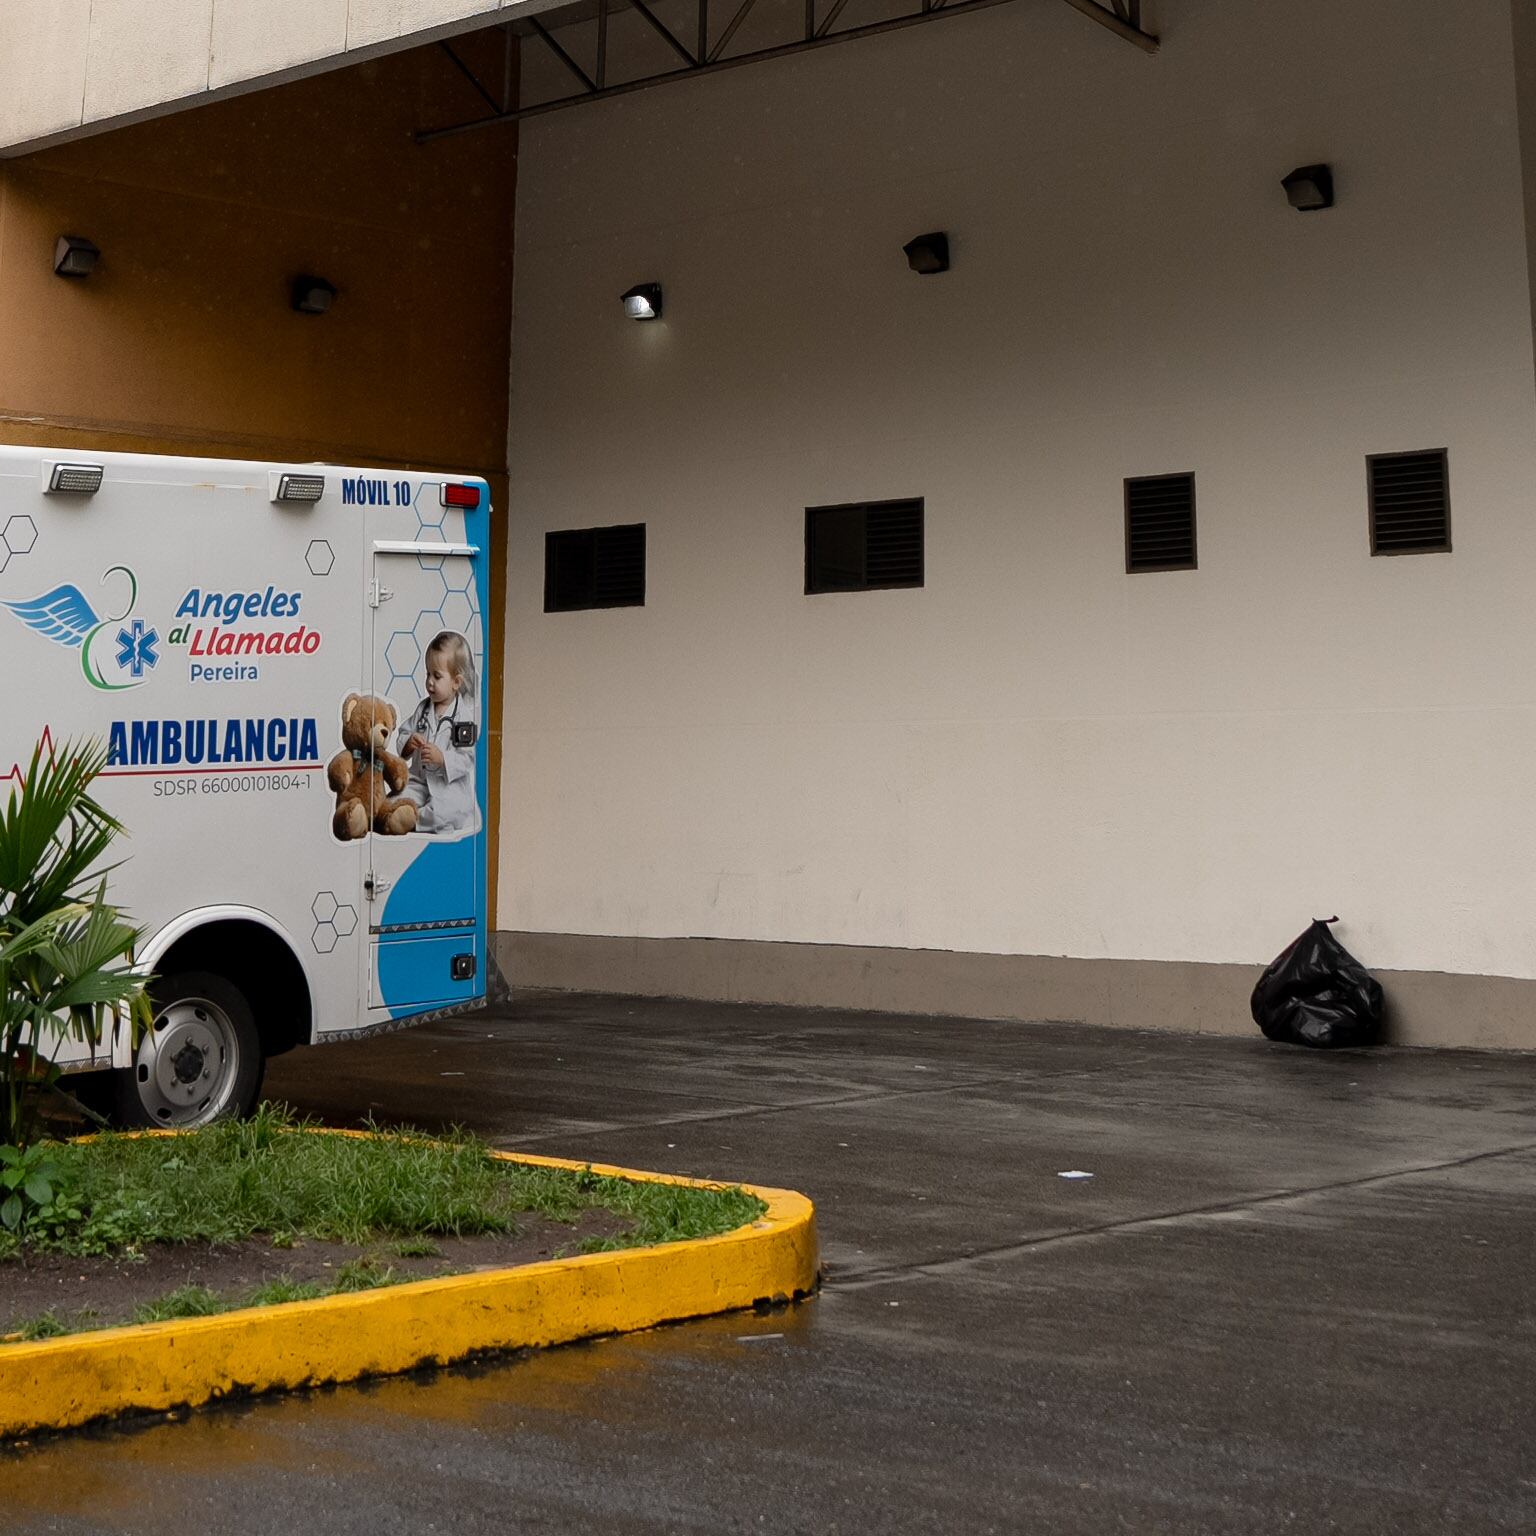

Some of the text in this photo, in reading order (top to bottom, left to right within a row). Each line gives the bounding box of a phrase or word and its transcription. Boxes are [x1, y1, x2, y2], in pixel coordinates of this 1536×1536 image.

[342, 475, 411, 507] MÓVIL 10
[175, 586, 302, 625] Angeles
[168, 623, 321, 656] al Llamado
[191, 661, 258, 682] Pereira
[106, 717, 319, 766] AMBULANCIA
[153, 774, 311, 797] SDSR 66000101804-1
